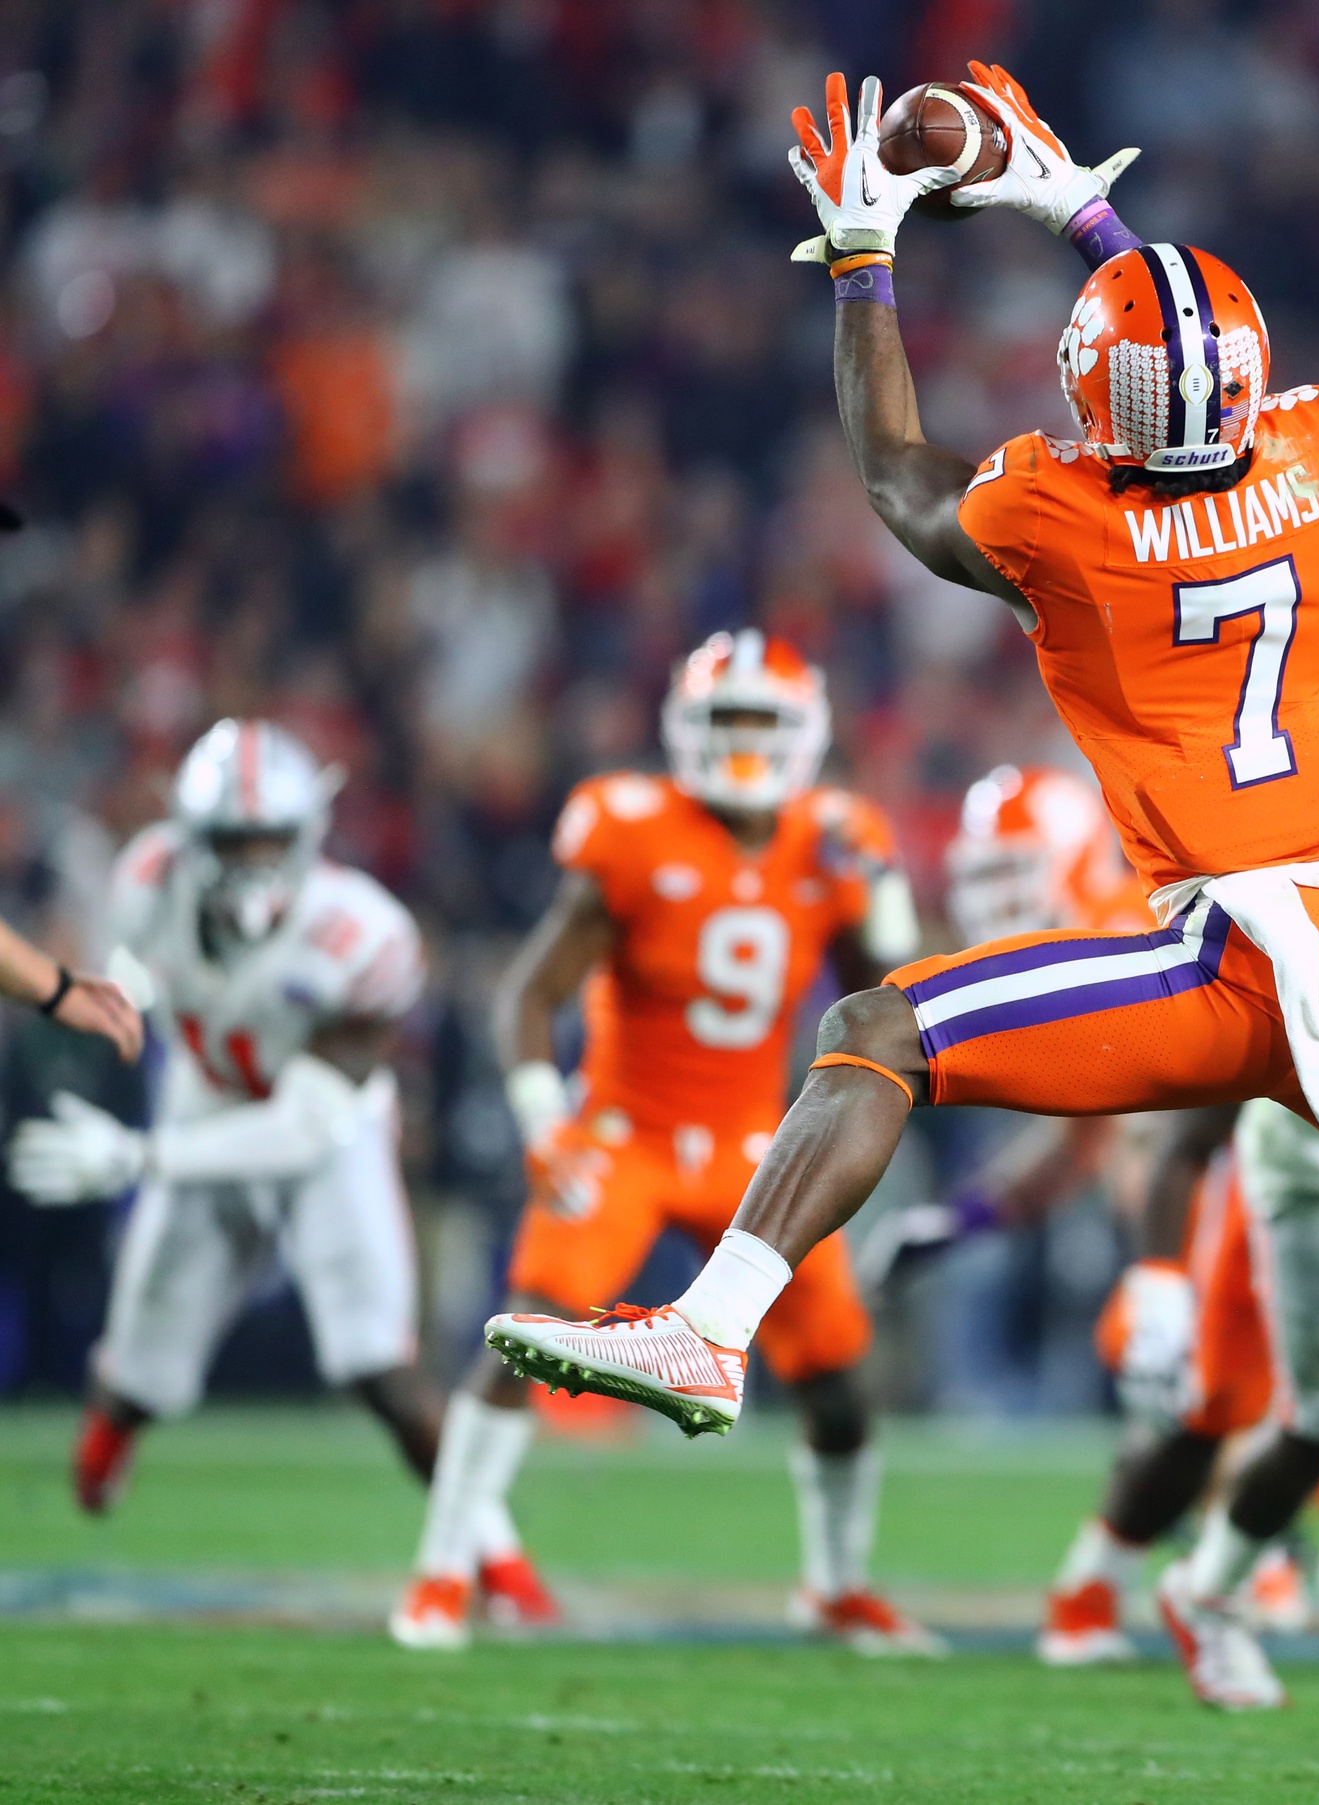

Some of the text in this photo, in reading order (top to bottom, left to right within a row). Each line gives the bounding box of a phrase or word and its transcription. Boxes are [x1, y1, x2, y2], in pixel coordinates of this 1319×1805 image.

[1161, 449, 1228, 466] schutt
[1207, 428, 1219, 444] 7
[1172, 553, 1302, 791] 7
[686, 903, 790, 1051] 9
